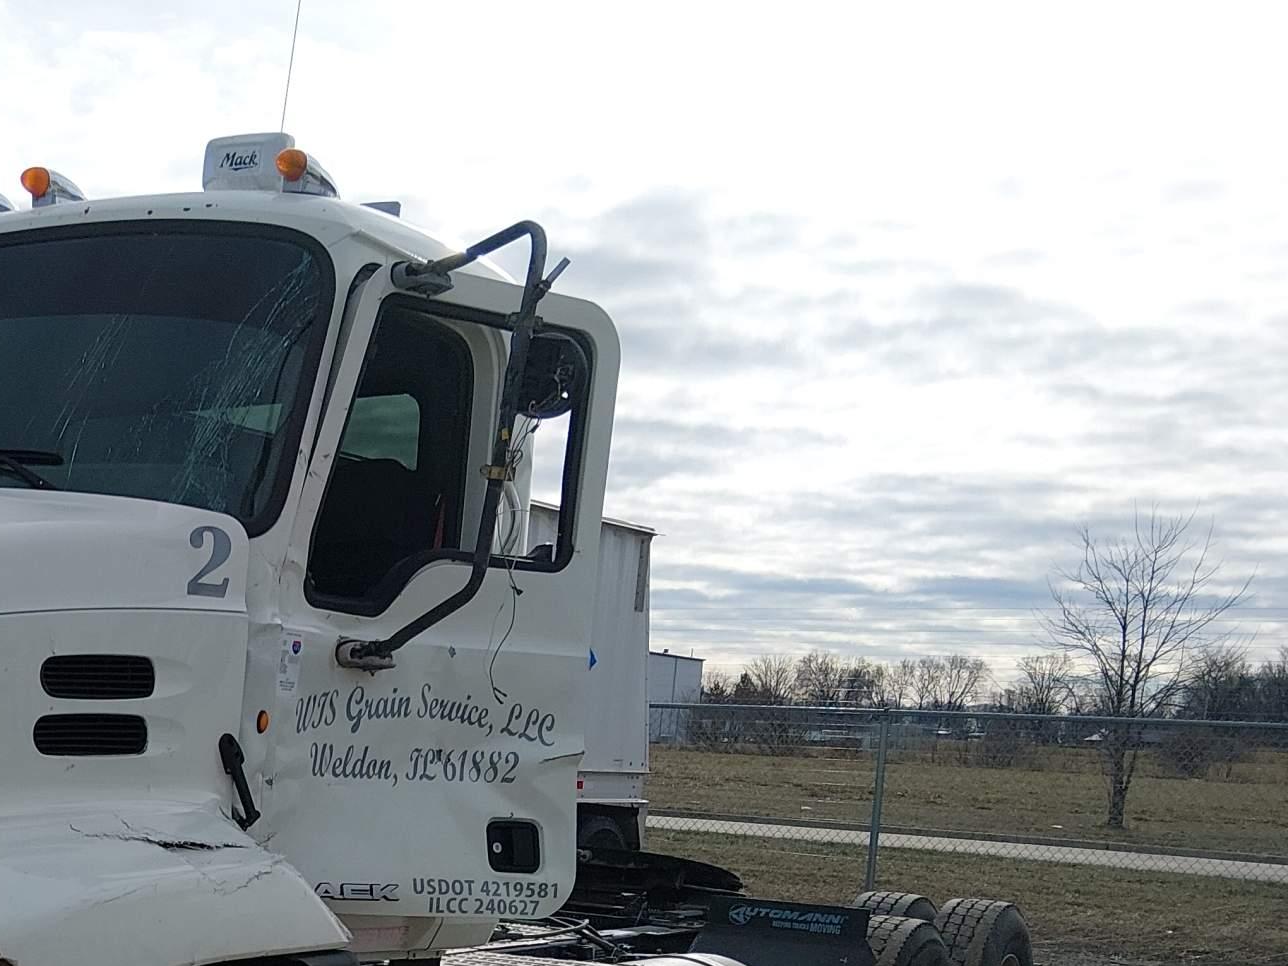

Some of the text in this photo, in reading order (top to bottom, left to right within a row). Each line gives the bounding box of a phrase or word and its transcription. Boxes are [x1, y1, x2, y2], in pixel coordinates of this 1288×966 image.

[219, 149, 258, 172] Mack
[187, 526, 232, 598] 2
[346, 685, 412, 734] Grain
[417, 683, 493, 737] Service,
[500, 703, 555, 747] LLC
[310, 741, 398, 787] Weldon,
[442, 749, 520, 784] 61882
[314, 882, 400, 901] ACK
[413, 877, 560, 899] USDOT 4219581
[429, 898, 540, 916] ILCC 240627
[729, 904, 843, 925] AUTOMANN
[810, 923, 841, 935] MOVING
